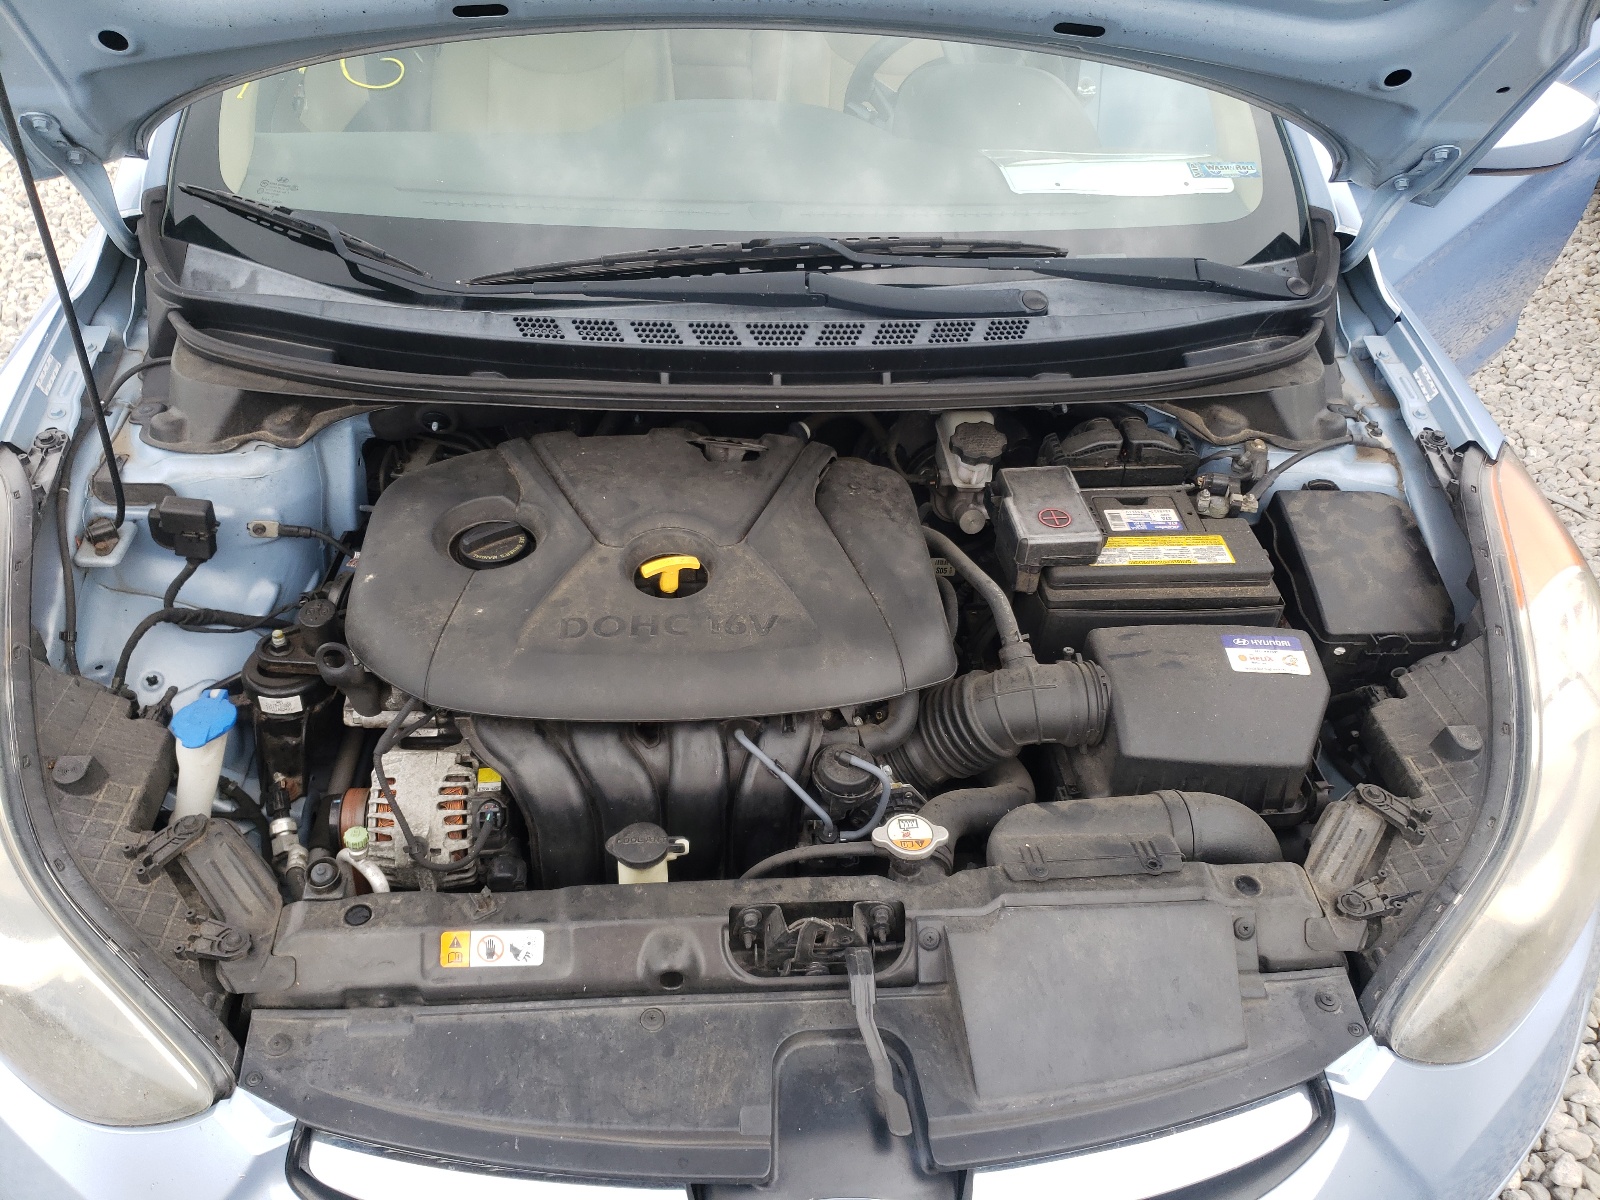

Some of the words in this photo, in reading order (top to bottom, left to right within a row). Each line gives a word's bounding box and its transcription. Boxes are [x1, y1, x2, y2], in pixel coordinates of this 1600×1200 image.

[558, 614, 690, 640] DOHC
[706, 613, 780, 637] 16V
[1250, 639, 1292, 647] HYUNDAI
